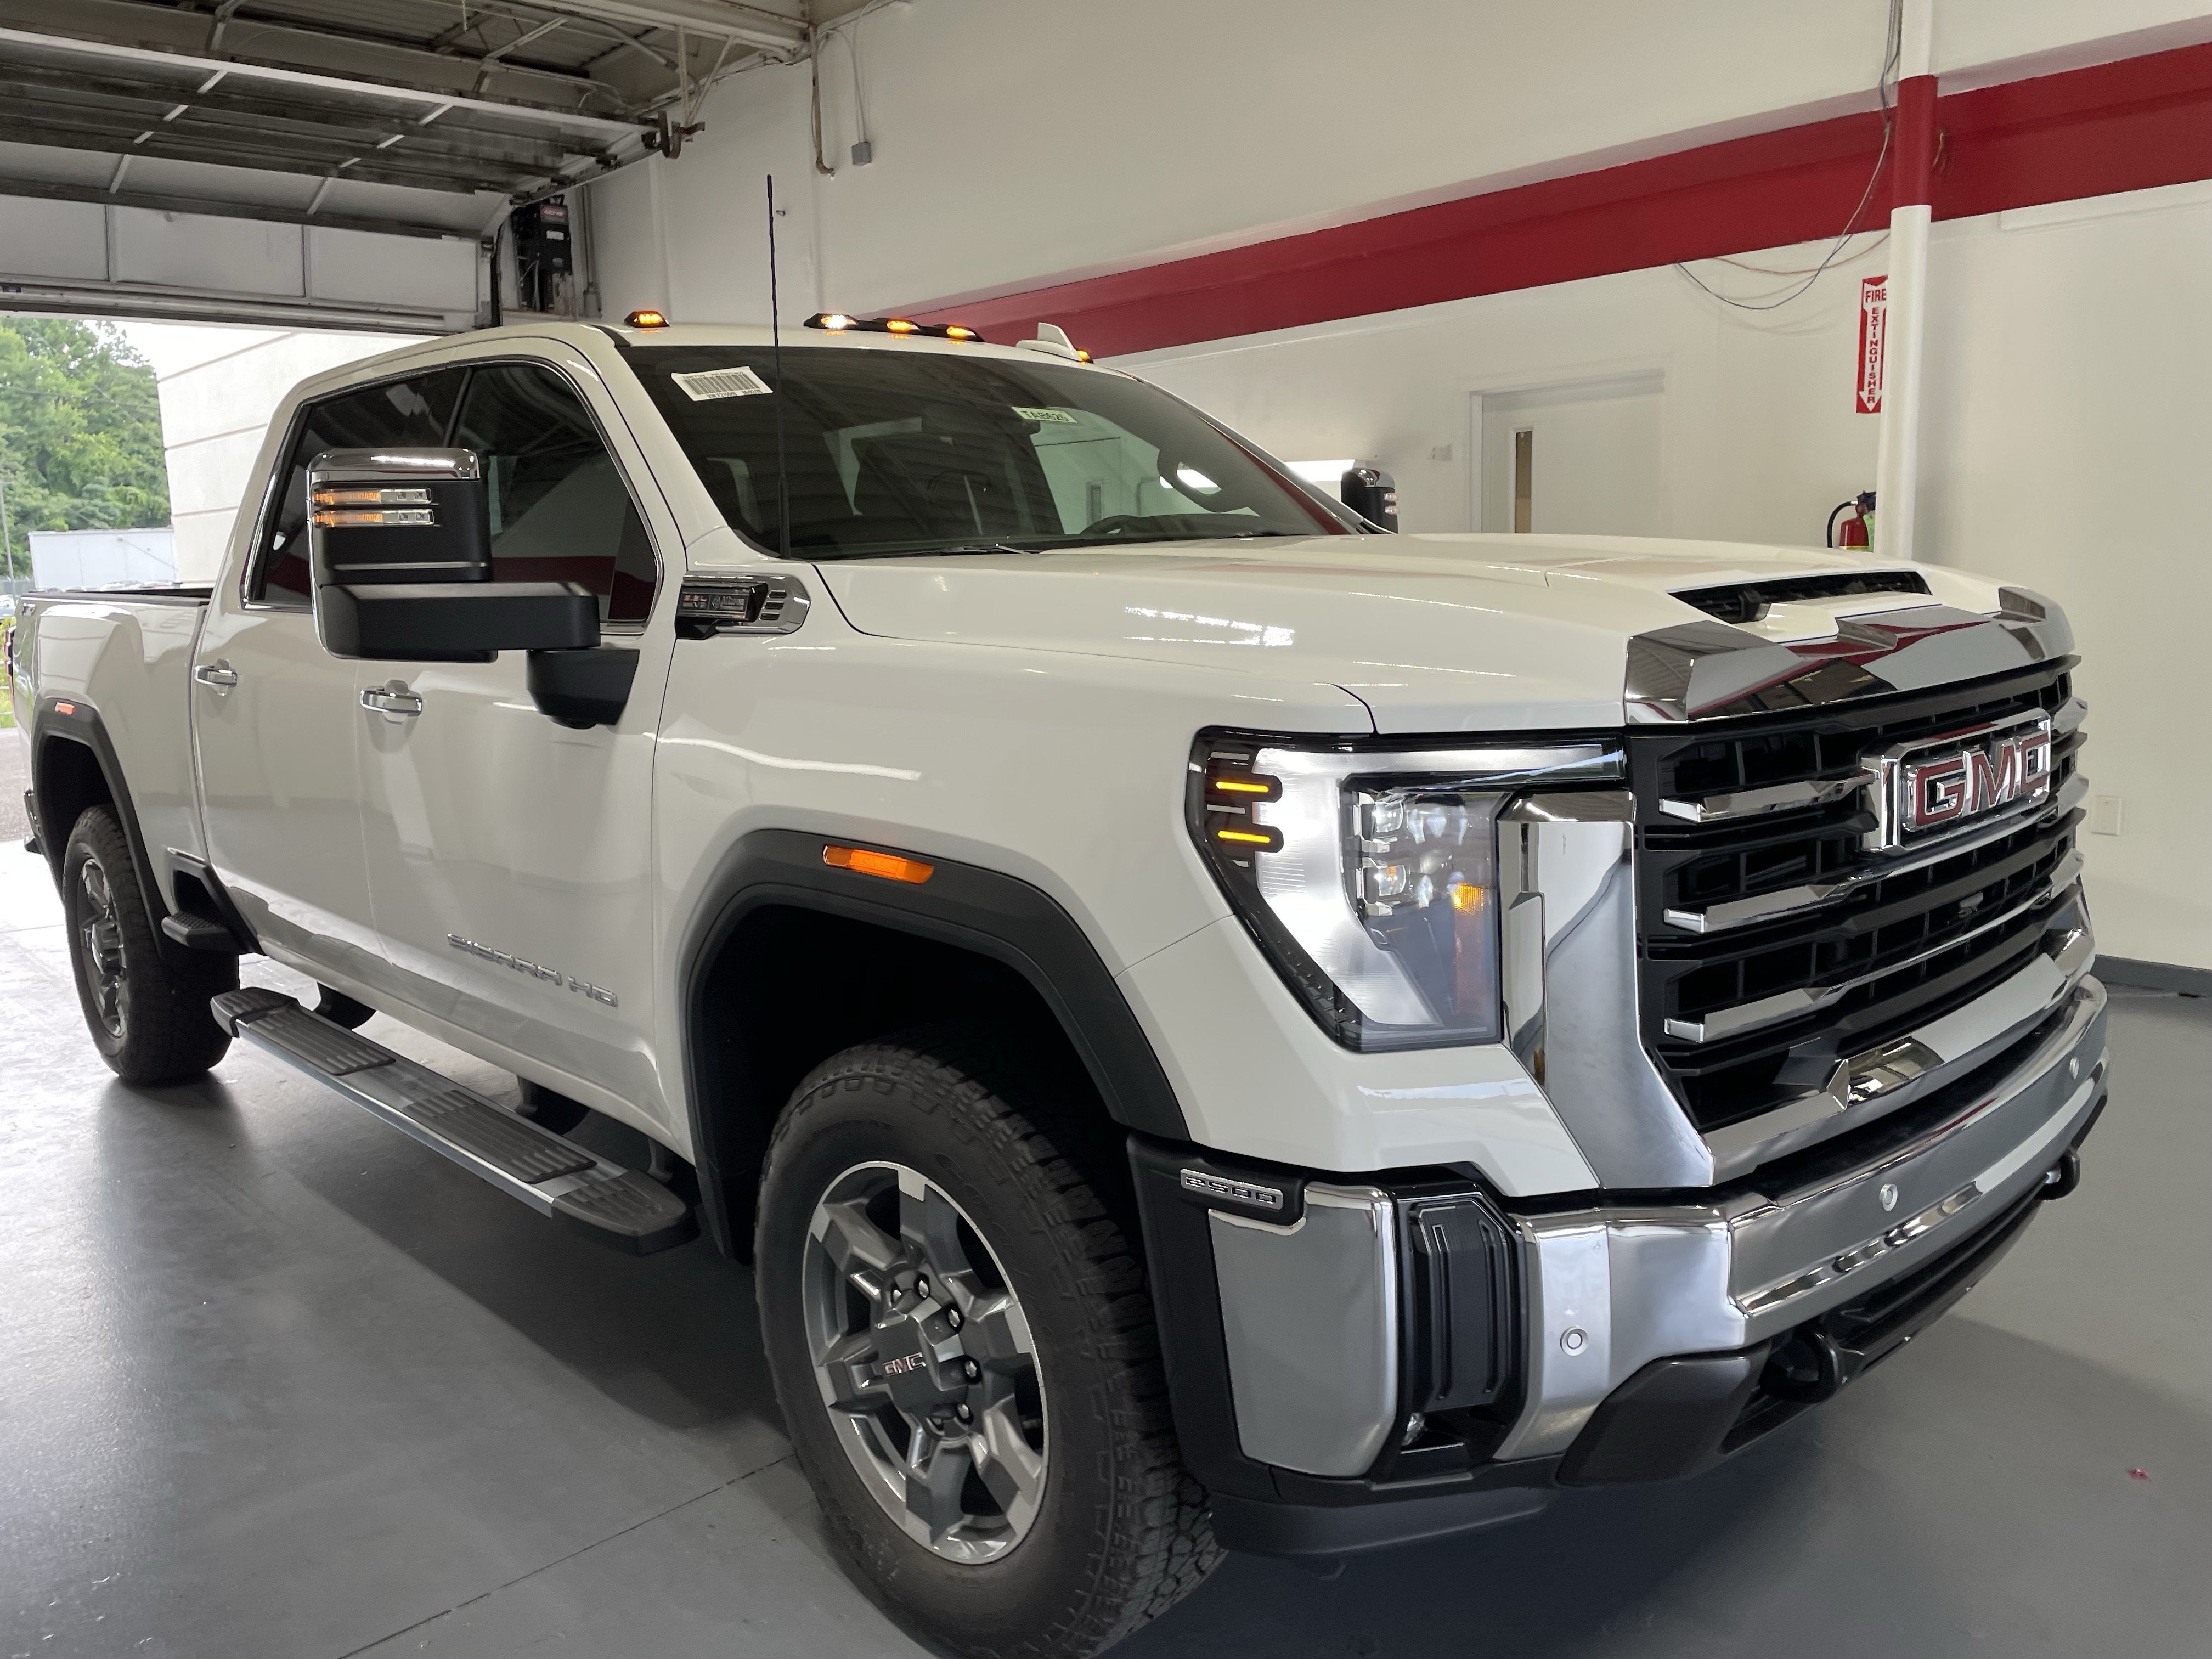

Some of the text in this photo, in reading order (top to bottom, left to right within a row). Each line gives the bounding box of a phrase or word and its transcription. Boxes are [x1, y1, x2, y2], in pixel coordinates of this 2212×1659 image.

[1865, 289, 1887, 303] FIRE
[1867, 307, 1879, 403] EXTINGUISHER
[1914, 730, 2051, 827] GMC
[883, 1352, 926, 1377] GMC
